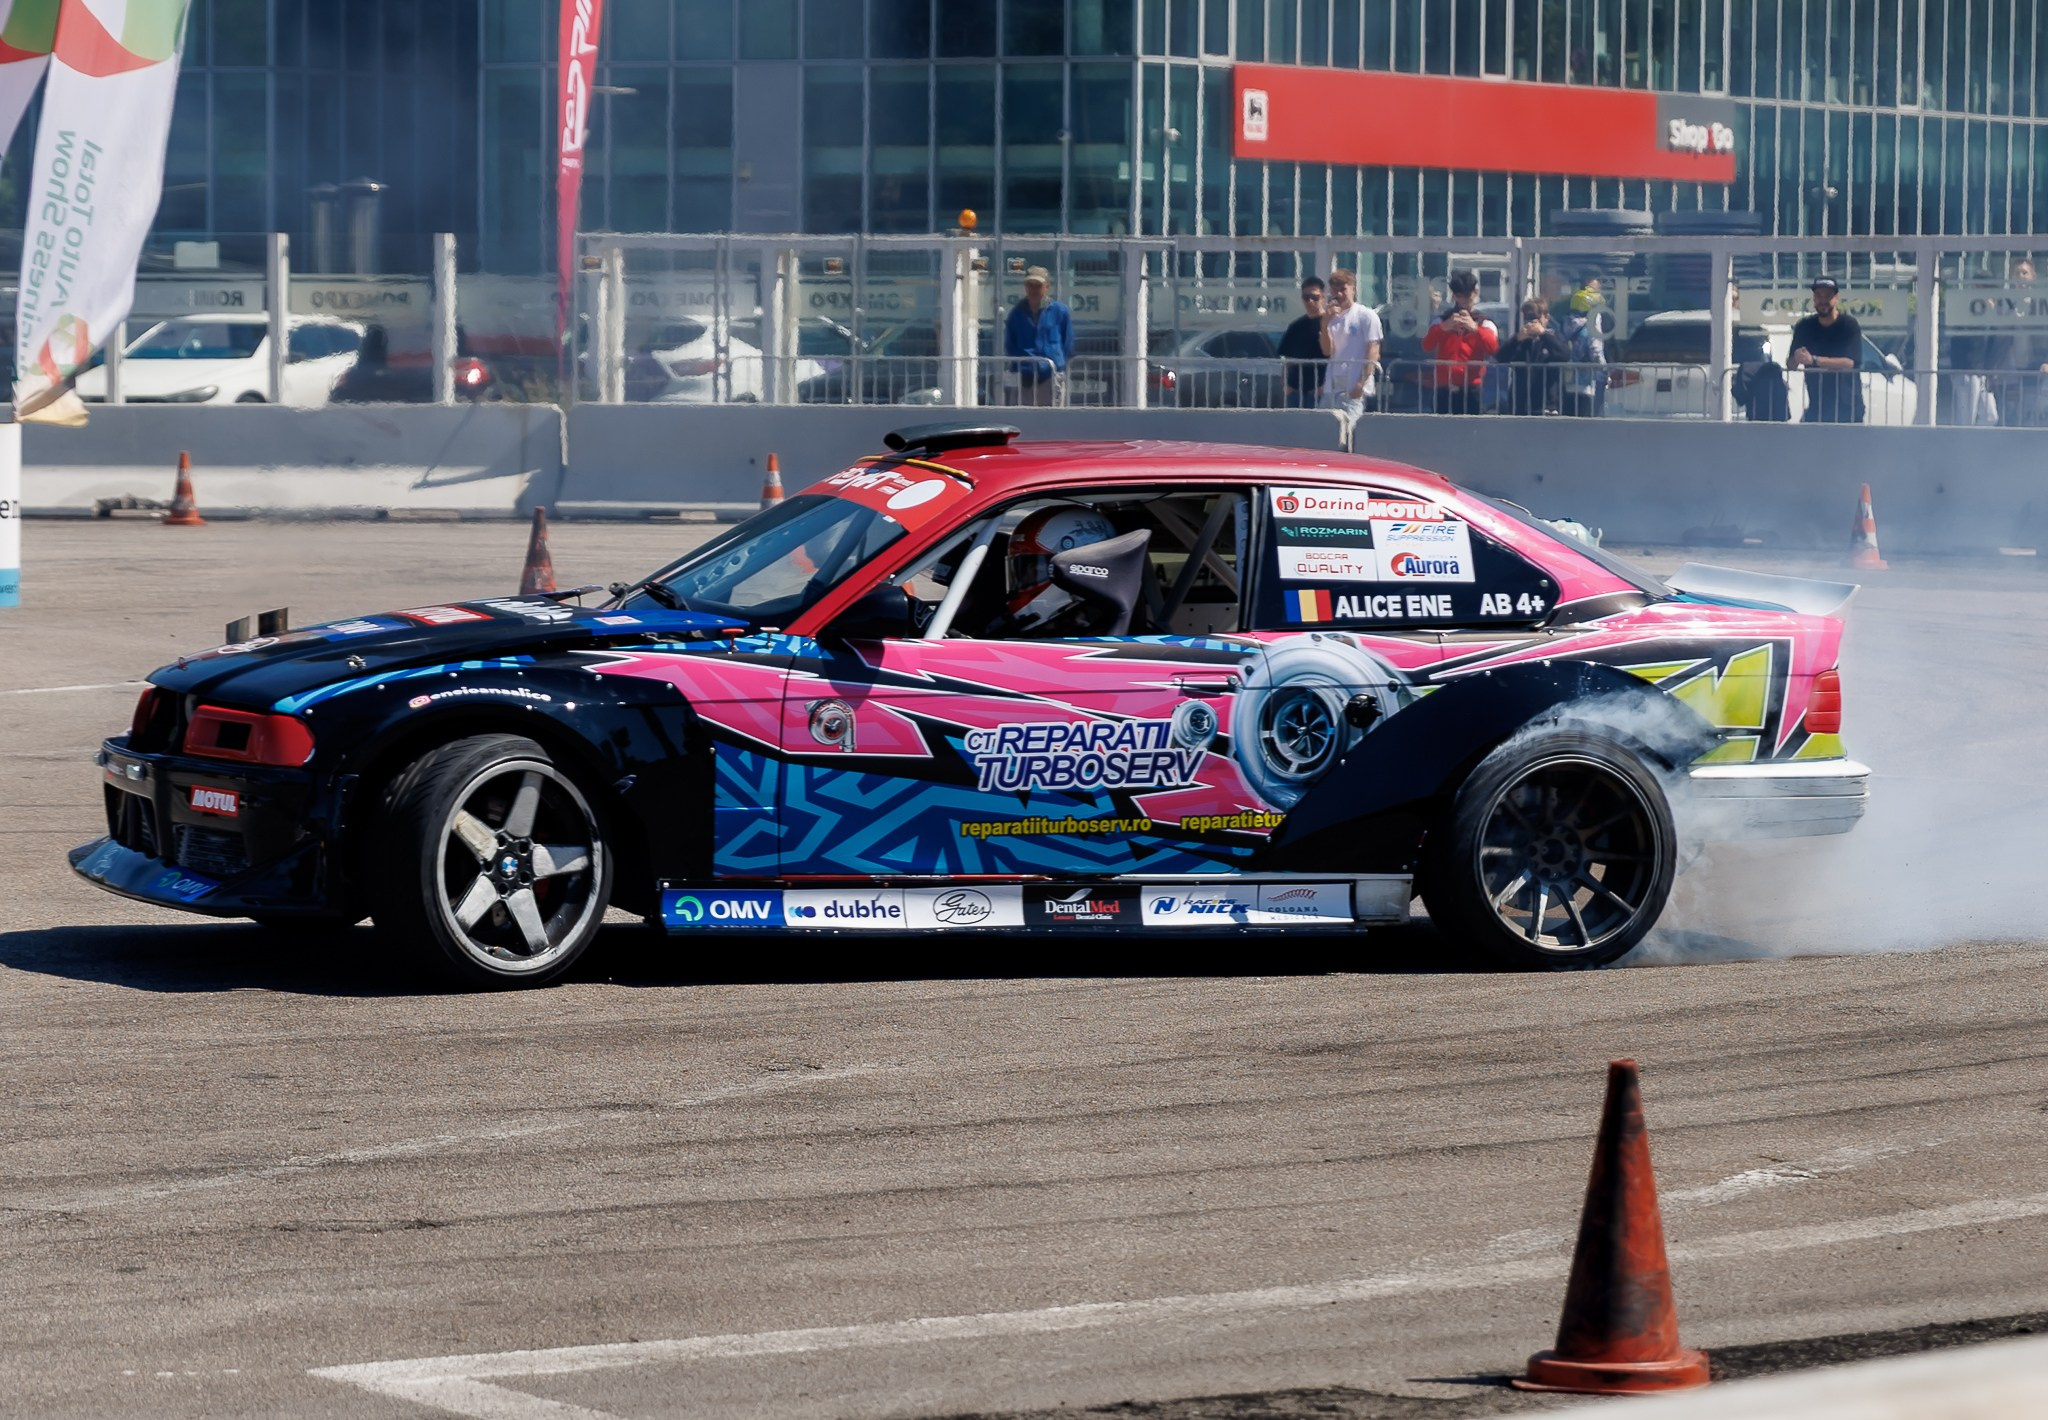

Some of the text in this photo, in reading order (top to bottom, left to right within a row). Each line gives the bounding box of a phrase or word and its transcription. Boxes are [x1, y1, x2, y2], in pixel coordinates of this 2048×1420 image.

[1304, 496, 1365, 512] Darina
[1368, 501, 1445, 520] MOTUL
[1300, 526, 1369, 536] ROZMARIN
[1386, 534, 1455, 542] SUPPRESSION
[1421, 525, 1458, 535] FIRE
[1070, 563, 1109, 577] sparco
[1297, 563, 1363, 574] QUALITY
[1405, 557, 1460, 575] Aurora
[1335, 592, 1546, 618] ALICE ENE AB 4+
[967, 731, 996, 750] CT
[977, 751, 1206, 789] TURBOSERV
[191, 789, 237, 812] MOTUL
[960, 815, 1152, 839] reparatiiturboserv.ro
[1180, 811, 1287, 834] reparatietu
[709, 900, 772, 919] OMV
[823, 899, 901, 919] dubhe
[936, 893, 990, 922] Gates
[1045, 900, 1120, 914] DentalMed
[1188, 904, 1250, 914] NICK
